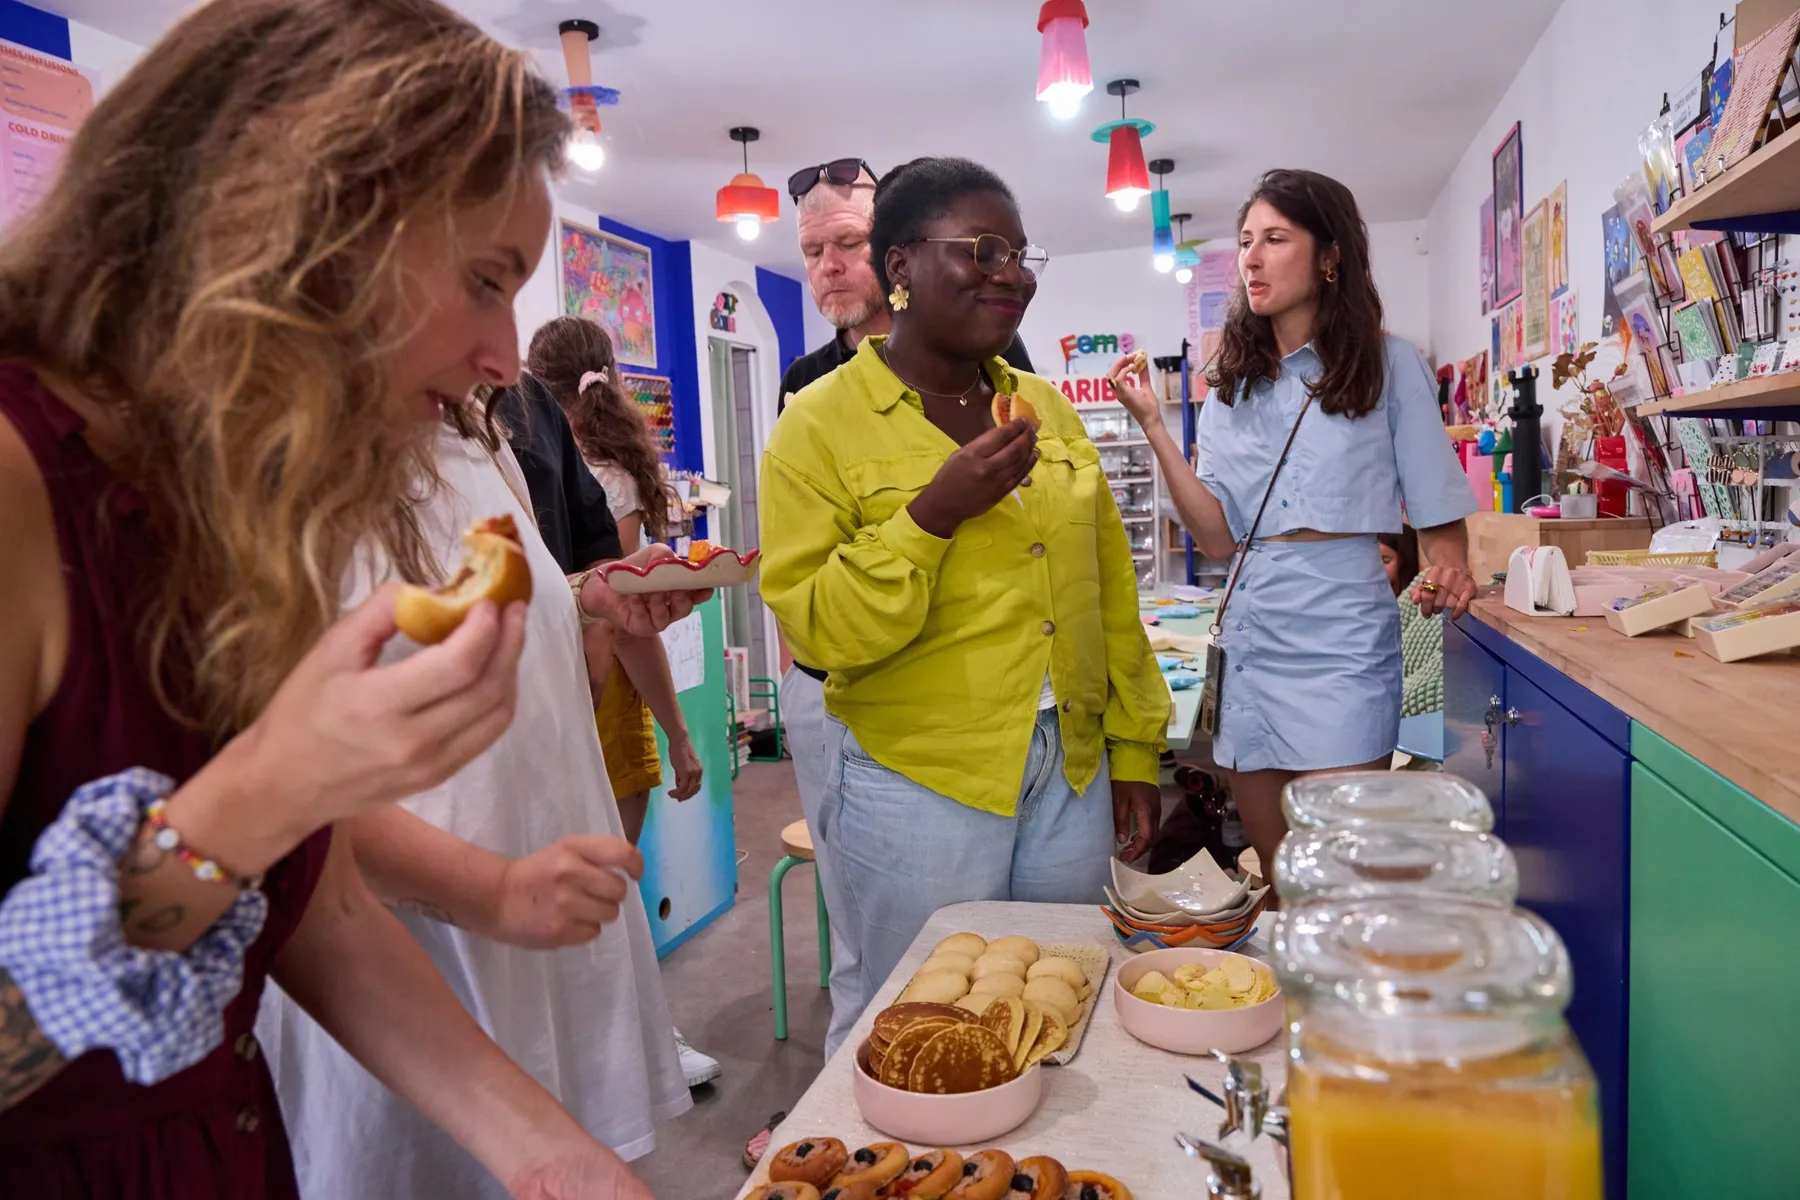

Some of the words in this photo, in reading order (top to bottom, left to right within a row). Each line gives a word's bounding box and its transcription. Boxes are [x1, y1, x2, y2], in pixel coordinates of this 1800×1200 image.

[8, 121, 39, 138] COLD
[41, 130, 67, 144] DRIN
[1051, 376, 1136, 404] ARIB
